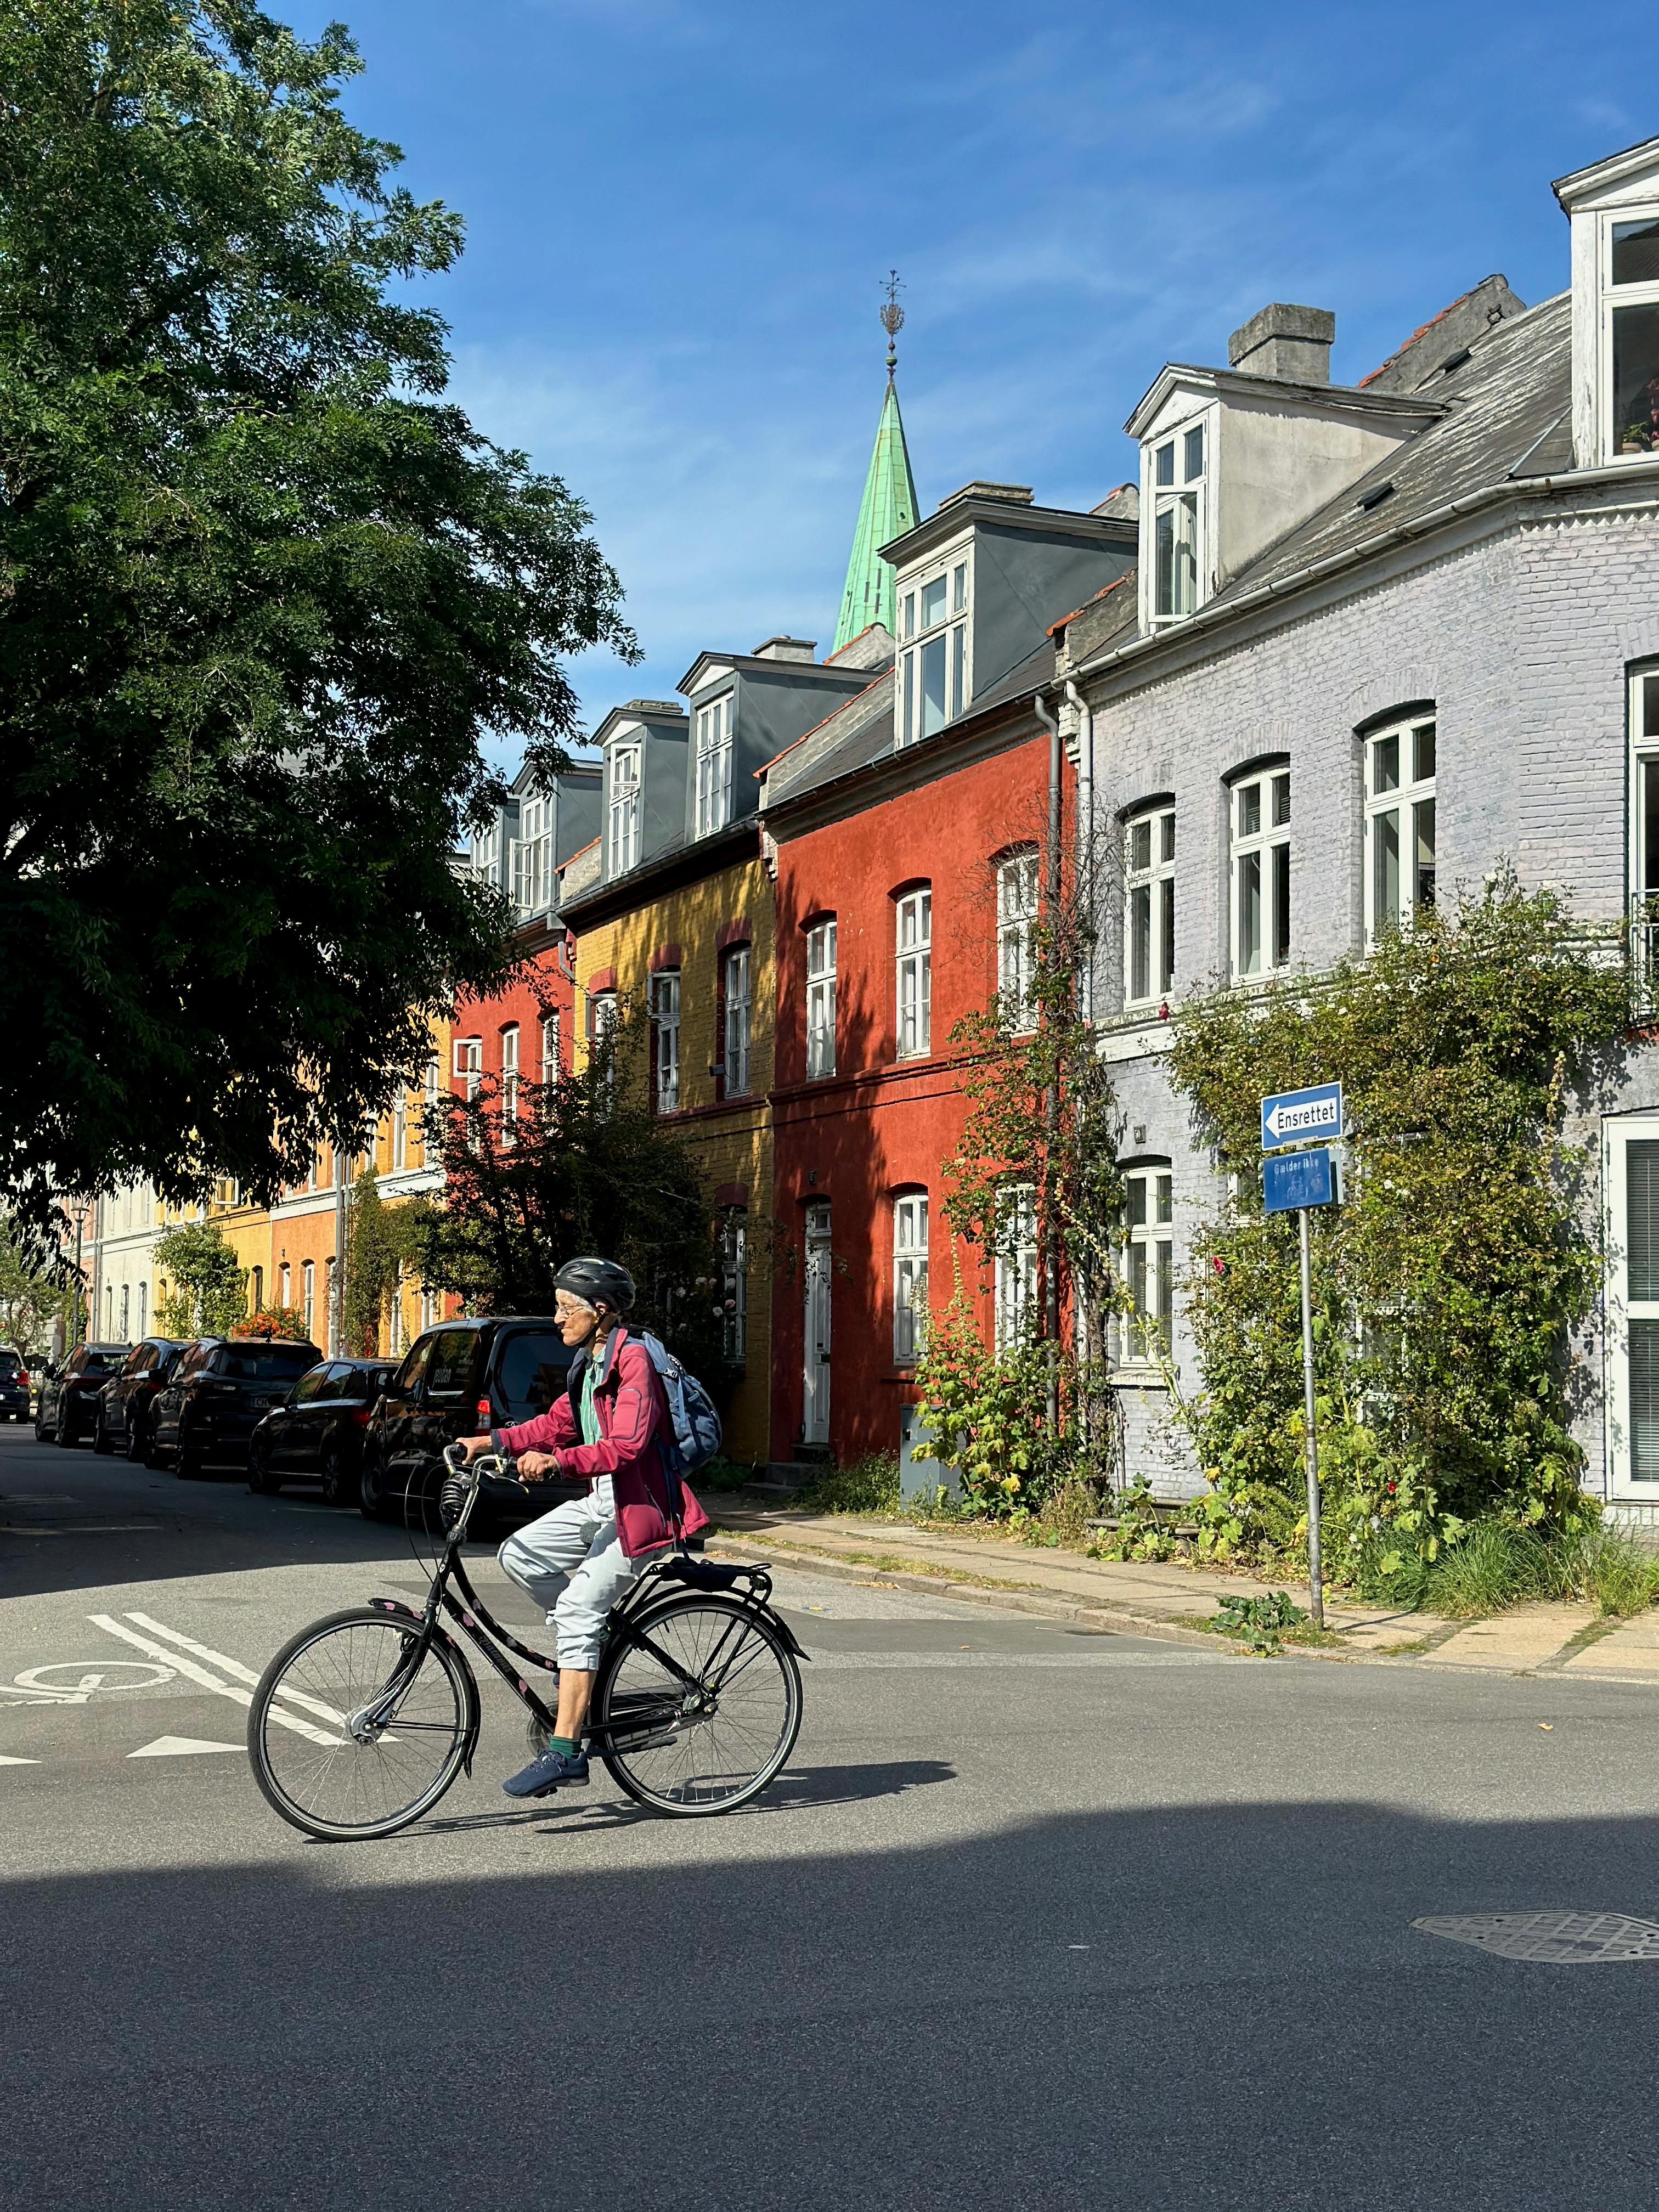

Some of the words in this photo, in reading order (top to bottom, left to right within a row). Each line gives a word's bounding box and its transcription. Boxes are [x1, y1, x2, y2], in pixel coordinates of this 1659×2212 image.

[1278, 1102, 1334, 1129] Ensrettet
[1274, 1160, 1301, 1174] Gælder
[1303, 1157, 1319, 1169] ikke
